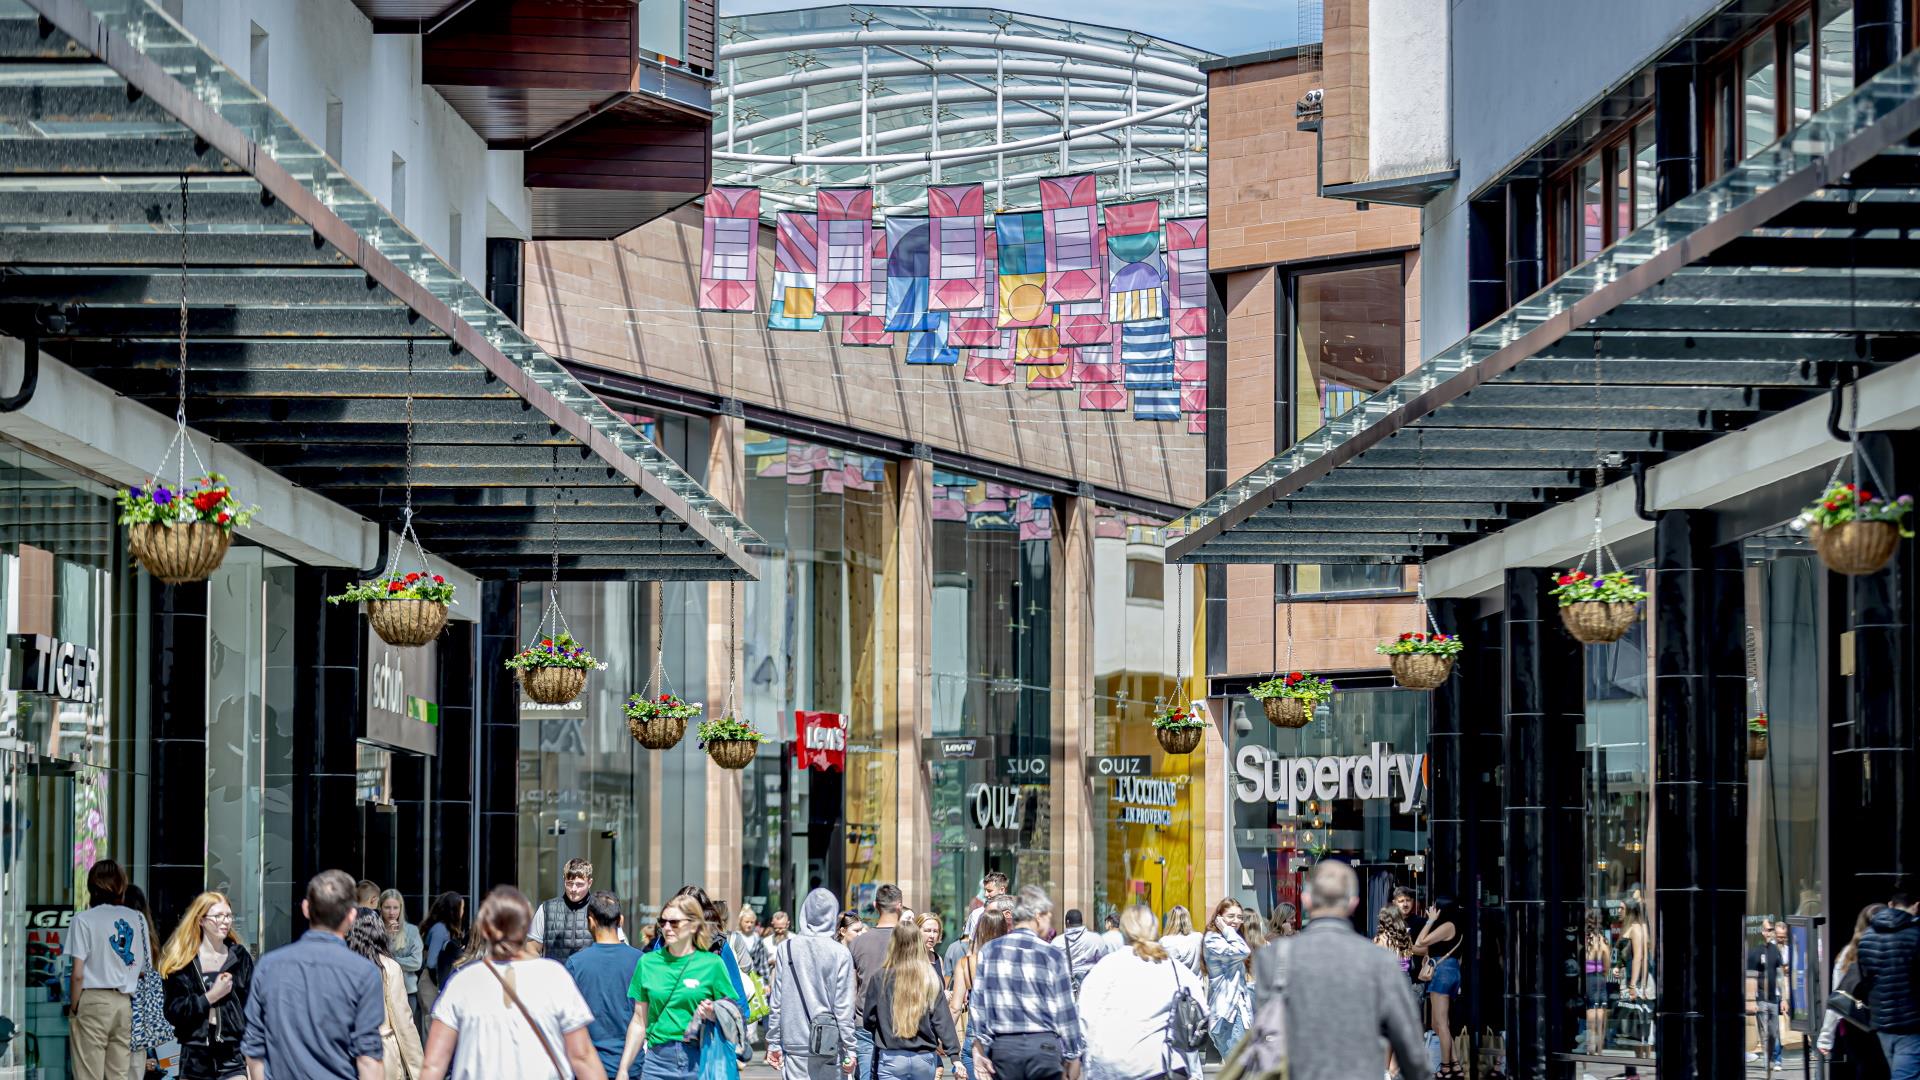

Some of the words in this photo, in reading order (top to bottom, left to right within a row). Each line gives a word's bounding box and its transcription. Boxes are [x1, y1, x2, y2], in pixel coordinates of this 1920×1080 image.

[35, 634, 100, 704] TIGER
[372, 651, 404, 715] schuh
[1098, 758, 1141, 775] QUIZ
[1235, 741, 1425, 817] Superdry
[976, 782, 1021, 831] QUIZ
[1125, 806, 1136, 823] EN
[1136, 807, 1172, 825] PROVENCE
[24, 910, 74, 928] IGE
